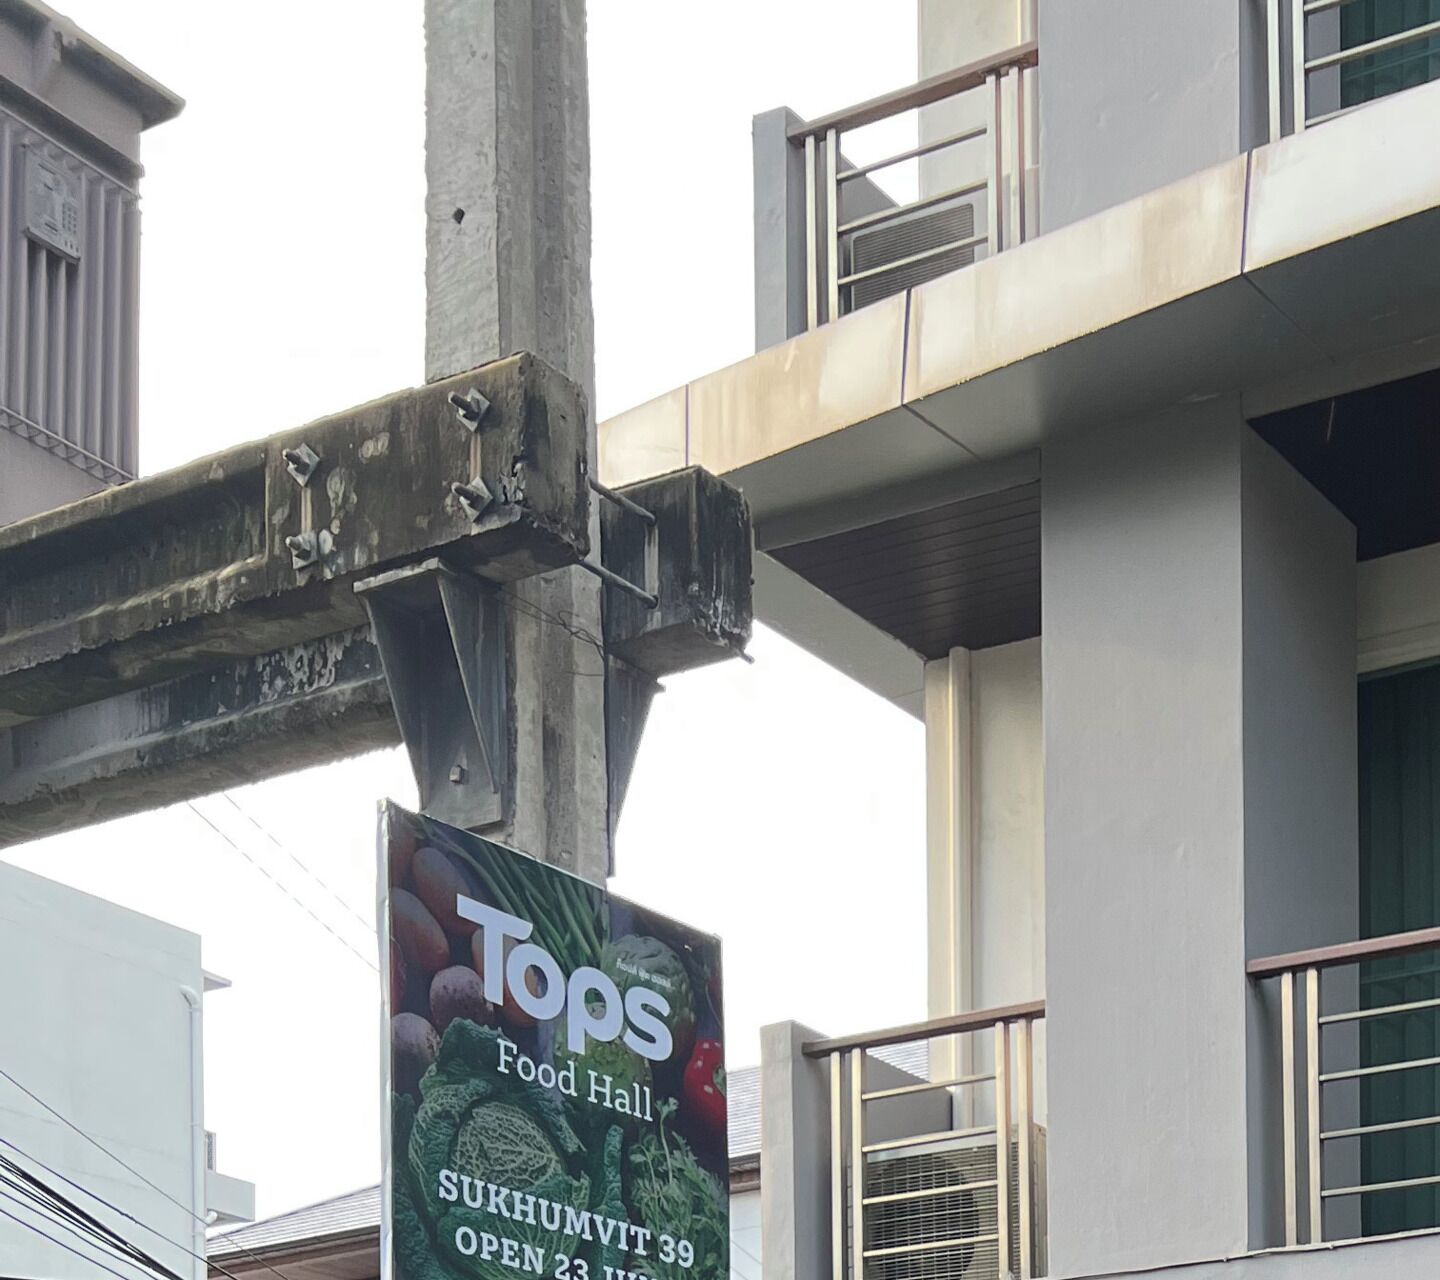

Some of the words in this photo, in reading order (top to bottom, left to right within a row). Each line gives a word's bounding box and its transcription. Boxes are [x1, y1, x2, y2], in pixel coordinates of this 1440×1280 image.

[457, 893, 673, 1062] Tops
[497, 1038, 578, 1097] Food
[587, 1069, 653, 1122] Hall
[438, 1169, 651, 1256] SUKHUMVIT
[658, 1233, 695, 1269] 39
[455, 1226, 545, 1275] OPEN
